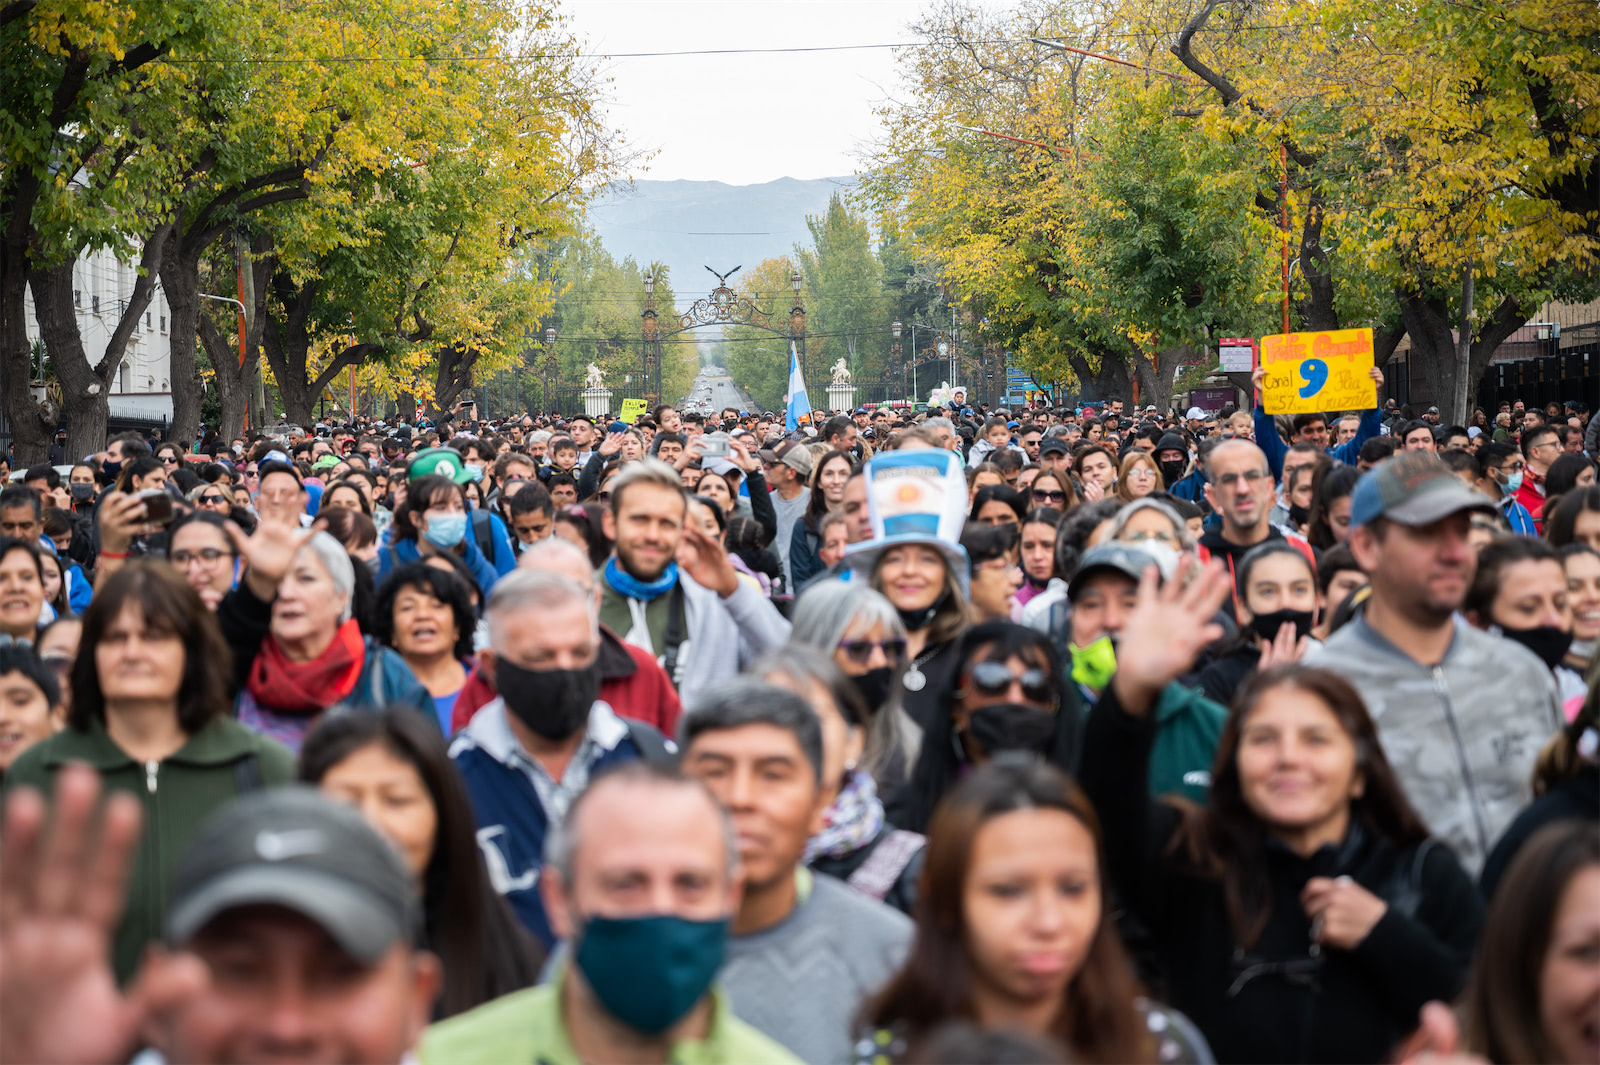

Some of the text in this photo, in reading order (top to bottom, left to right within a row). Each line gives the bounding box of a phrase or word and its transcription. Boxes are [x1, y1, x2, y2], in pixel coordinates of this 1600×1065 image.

[1263, 359, 1329, 399] Canal 9
[1279, 395, 1295, 410] 57
